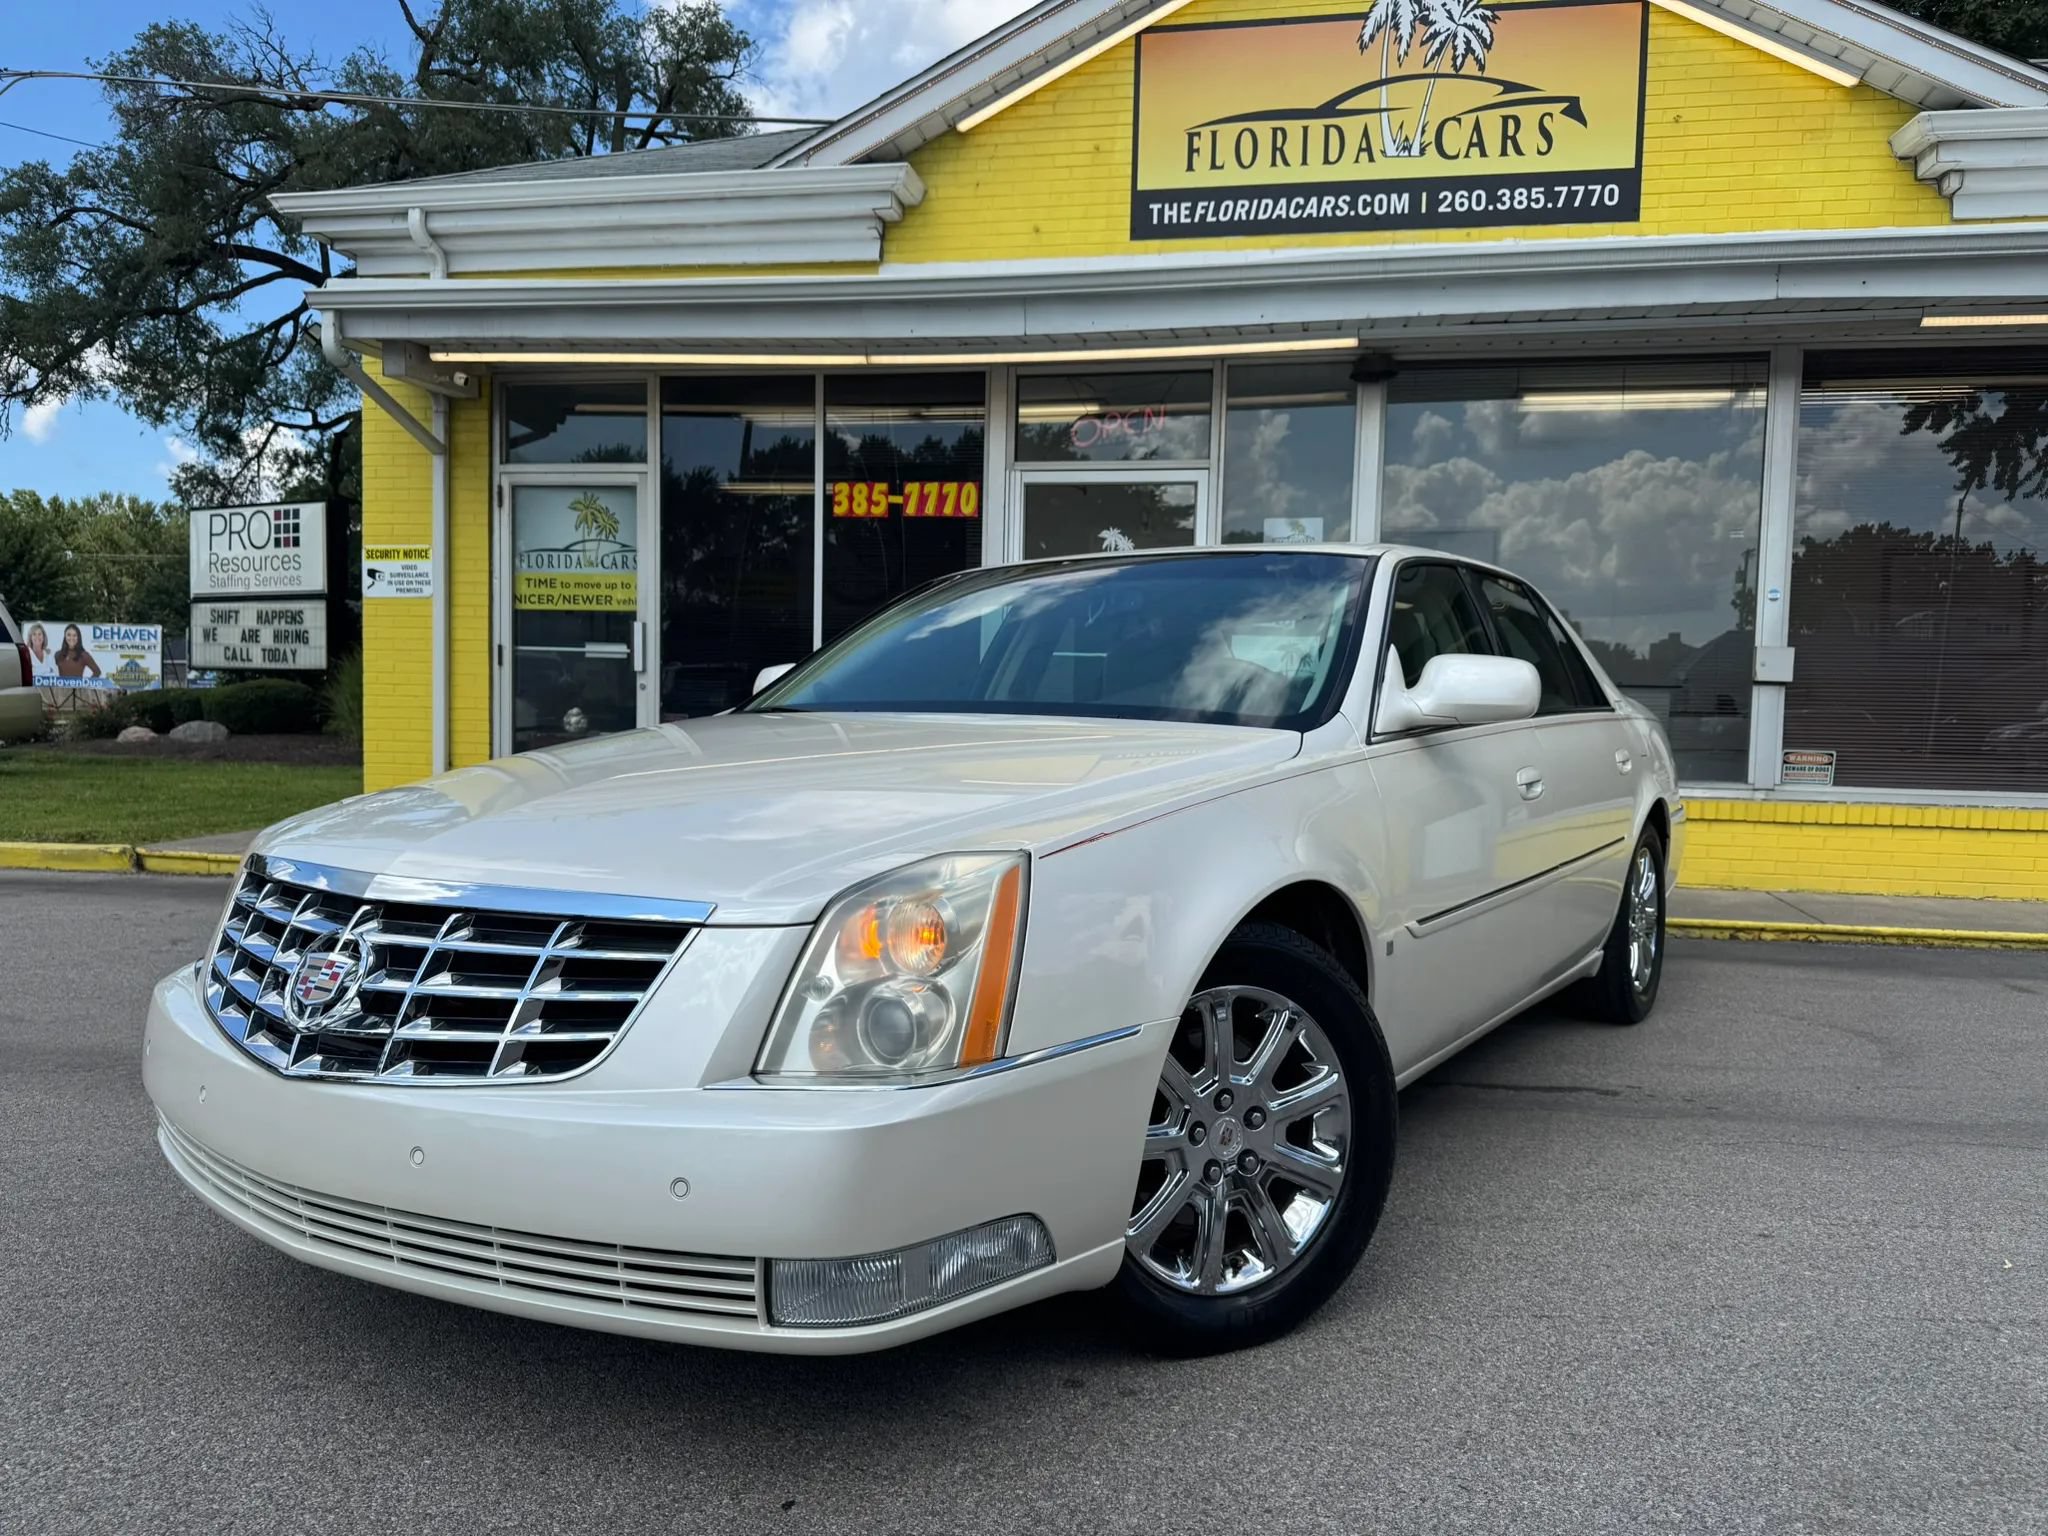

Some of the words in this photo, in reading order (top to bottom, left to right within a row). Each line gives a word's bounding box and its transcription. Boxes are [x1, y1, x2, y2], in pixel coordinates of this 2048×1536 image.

[1185, 122, 1377, 173] FLORIDA
[1434, 111, 1555, 161] CARS
[1149, 192, 1411, 225] THEFLORIDACARS.COM
[1437, 183, 1620, 214] 260.385.7770
[1070, 405, 1167, 448] OPEN
[833, 482, 978, 516] 385-7770
[209, 509, 272, 551] PRO
[209, 552, 302, 573] Resources
[365, 548, 401, 560] SECURITY
[402, 548, 430, 560] NOTICE
[519, 553, 583, 569] FLORIDA
[600, 553, 637, 570] CARS
[209, 574, 250, 589] Staffing
[254, 574, 302, 587] Services
[525, 577, 557, 589] TIME
[560, 580, 571, 589] to
[574, 580, 601, 589] move
[604, 581, 618, 590] up
[620, 580, 632, 589] to
[514, 594, 613, 606] NICER/NEWER
[210, 608, 240, 625] SHIFT
[256, 609, 305, 625] HAPPENS
[202, 627, 218, 642] WE
[240, 628, 260, 644] ARE
[273, 628, 309, 645] HIRING
[224, 646, 253, 662] CALL
[261, 648, 297, 664] TODAY
